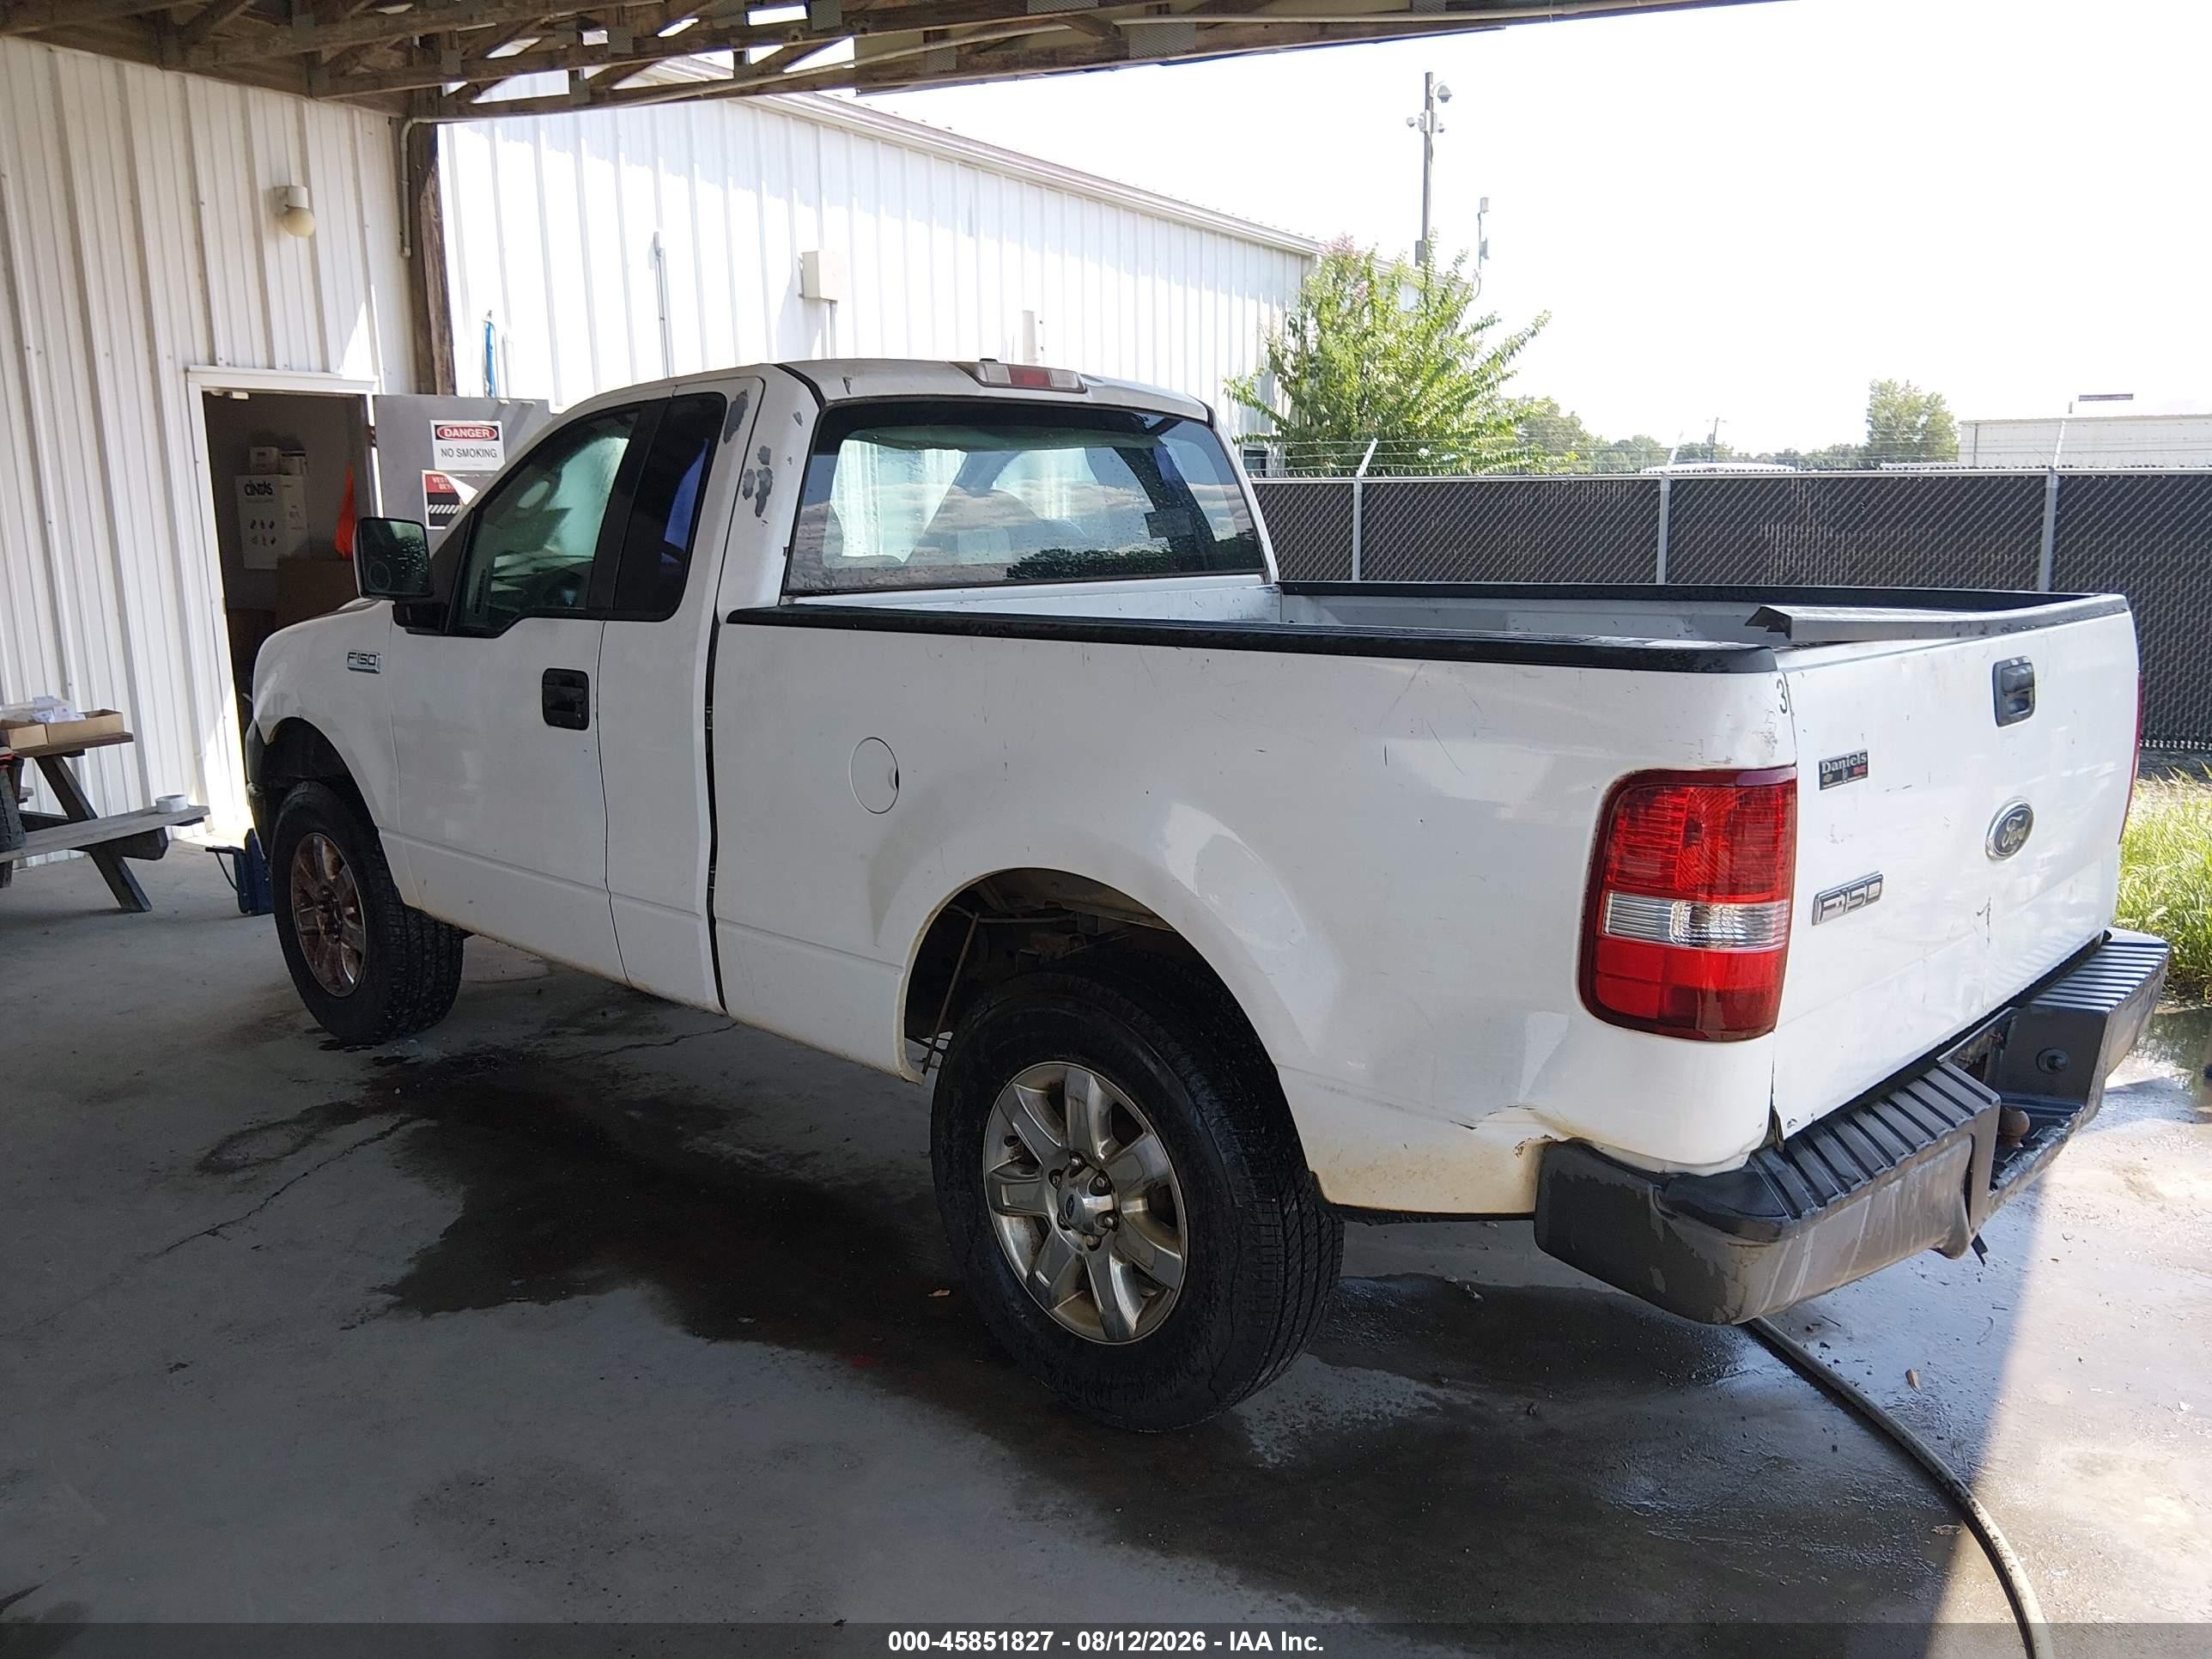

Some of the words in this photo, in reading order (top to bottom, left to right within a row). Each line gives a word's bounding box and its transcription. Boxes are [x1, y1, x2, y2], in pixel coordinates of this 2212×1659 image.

[443, 427, 490, 439] DANGER
[441, 448, 454, 458] NO
[456, 448, 498, 459] SMOKING
[1777, 678, 1788, 714] 3
[1821, 752, 1867, 774] Daniels
